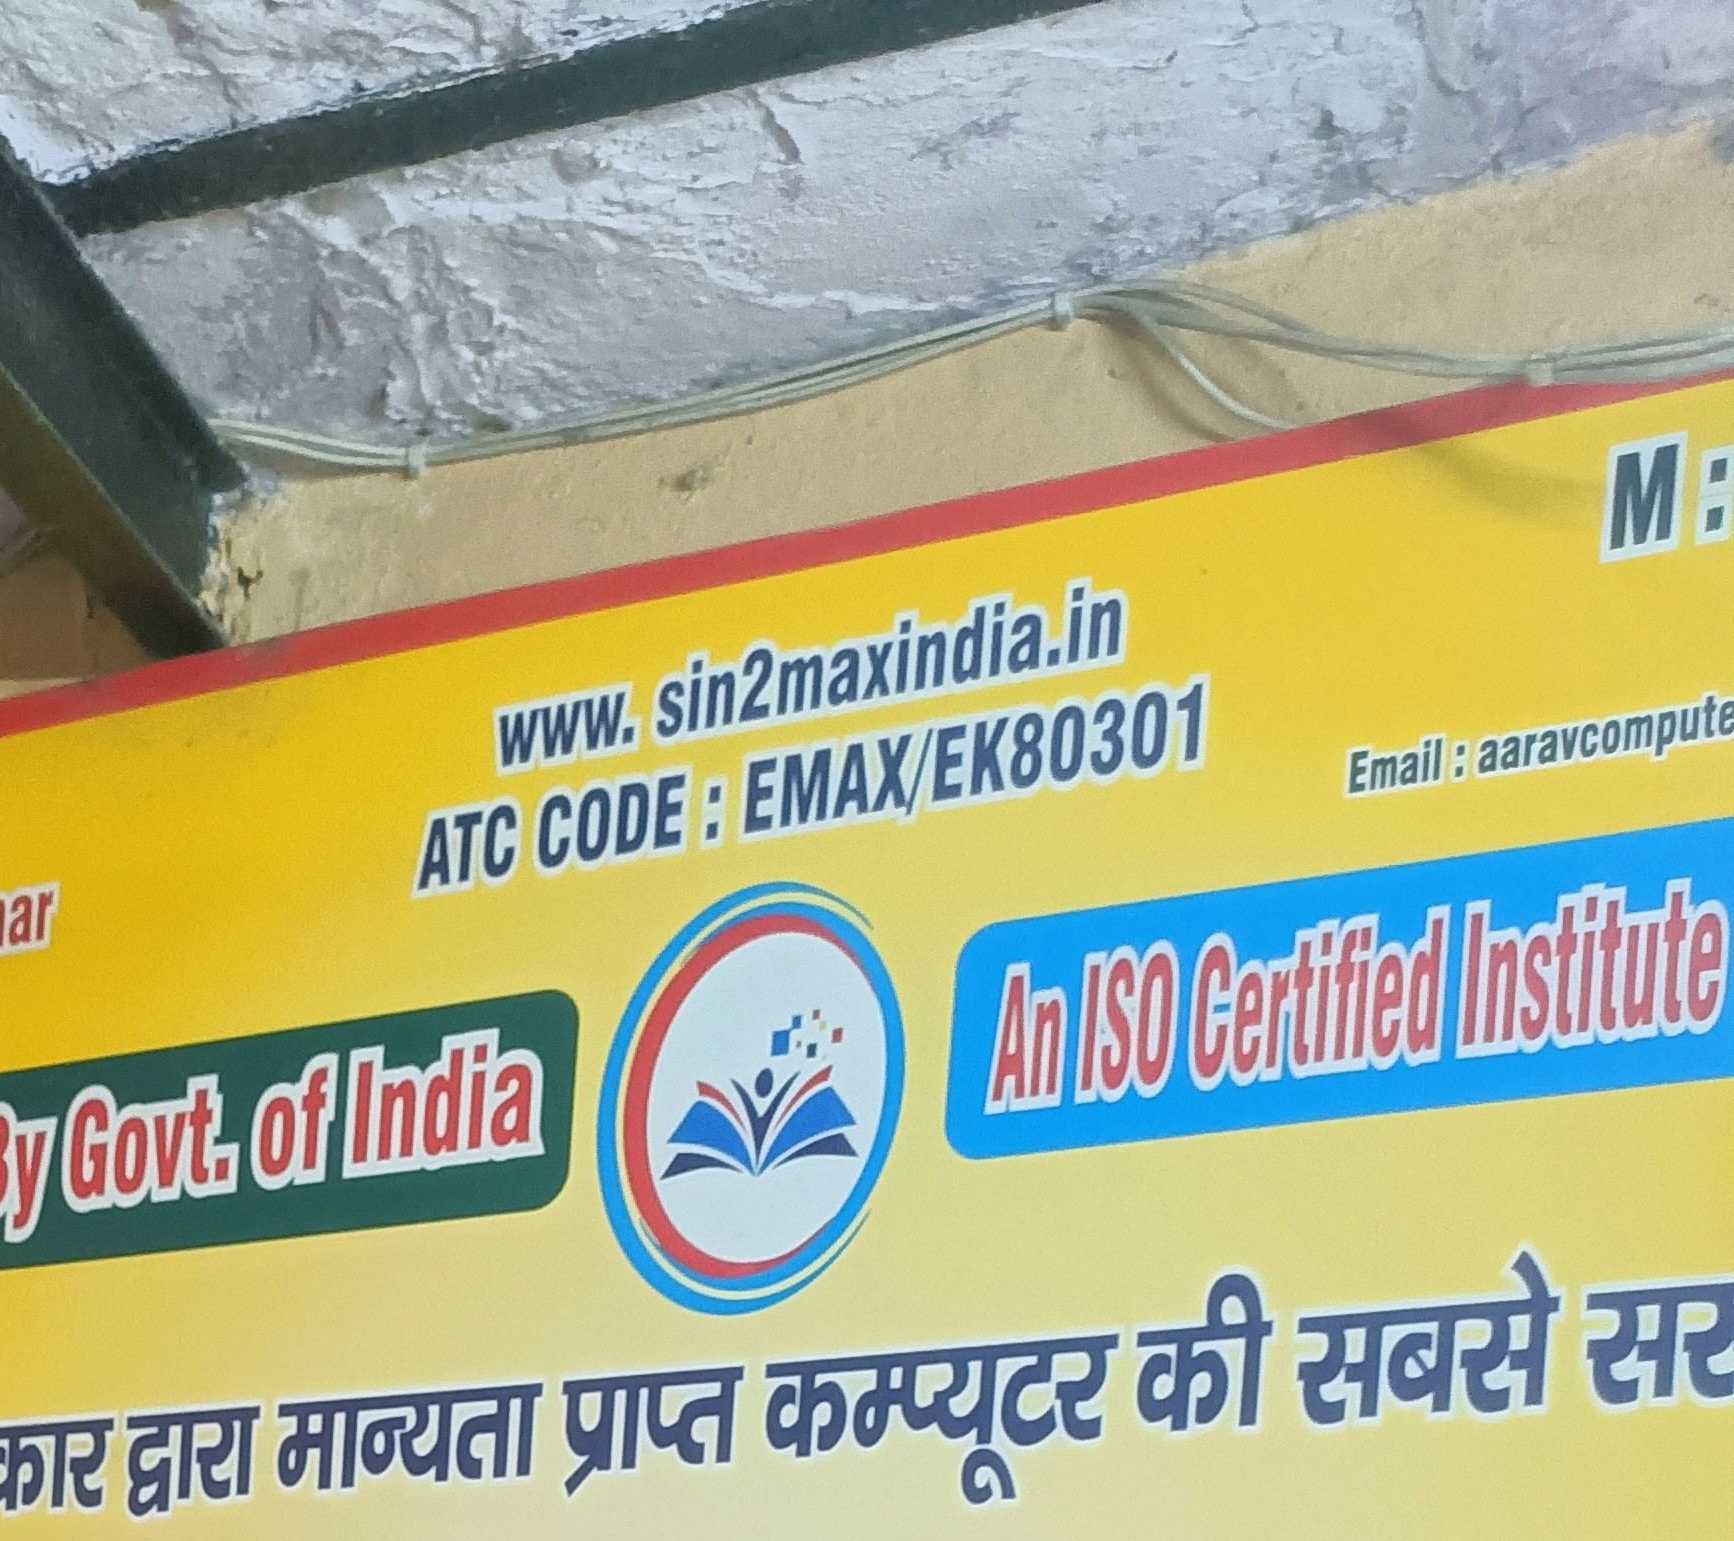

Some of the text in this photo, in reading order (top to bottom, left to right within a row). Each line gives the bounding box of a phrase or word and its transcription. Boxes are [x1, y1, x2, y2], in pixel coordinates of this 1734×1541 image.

[1608, 442, 1728, 552] M :
[499, 587, 1125, 767] www. sin2maxindia.in
[1347, 739, 1443, 793] Email
[419, 811, 516, 892] ATC
[539, 779, 687, 870] CODE
[745, 681, 1208, 833] EMAX/EK80301
[989, 881, 1723, 1100] An ISO Certified Institute
[70, 1083, 230, 1200] Govt.
[260, 1066, 330, 1178] of
[354, 1044, 533, 1161] India
[127, 1402, 260, 1516] द्वारा
[277, 1381, 543, 1493] मान्यता
[563, 1366, 743, 1496] प्राप्त
[766, 1333, 1118, 1502] कम्प्यूटर
[1136, 1273, 1271, 1432] की
[1297, 1250, 1560, 1424] सबसे
